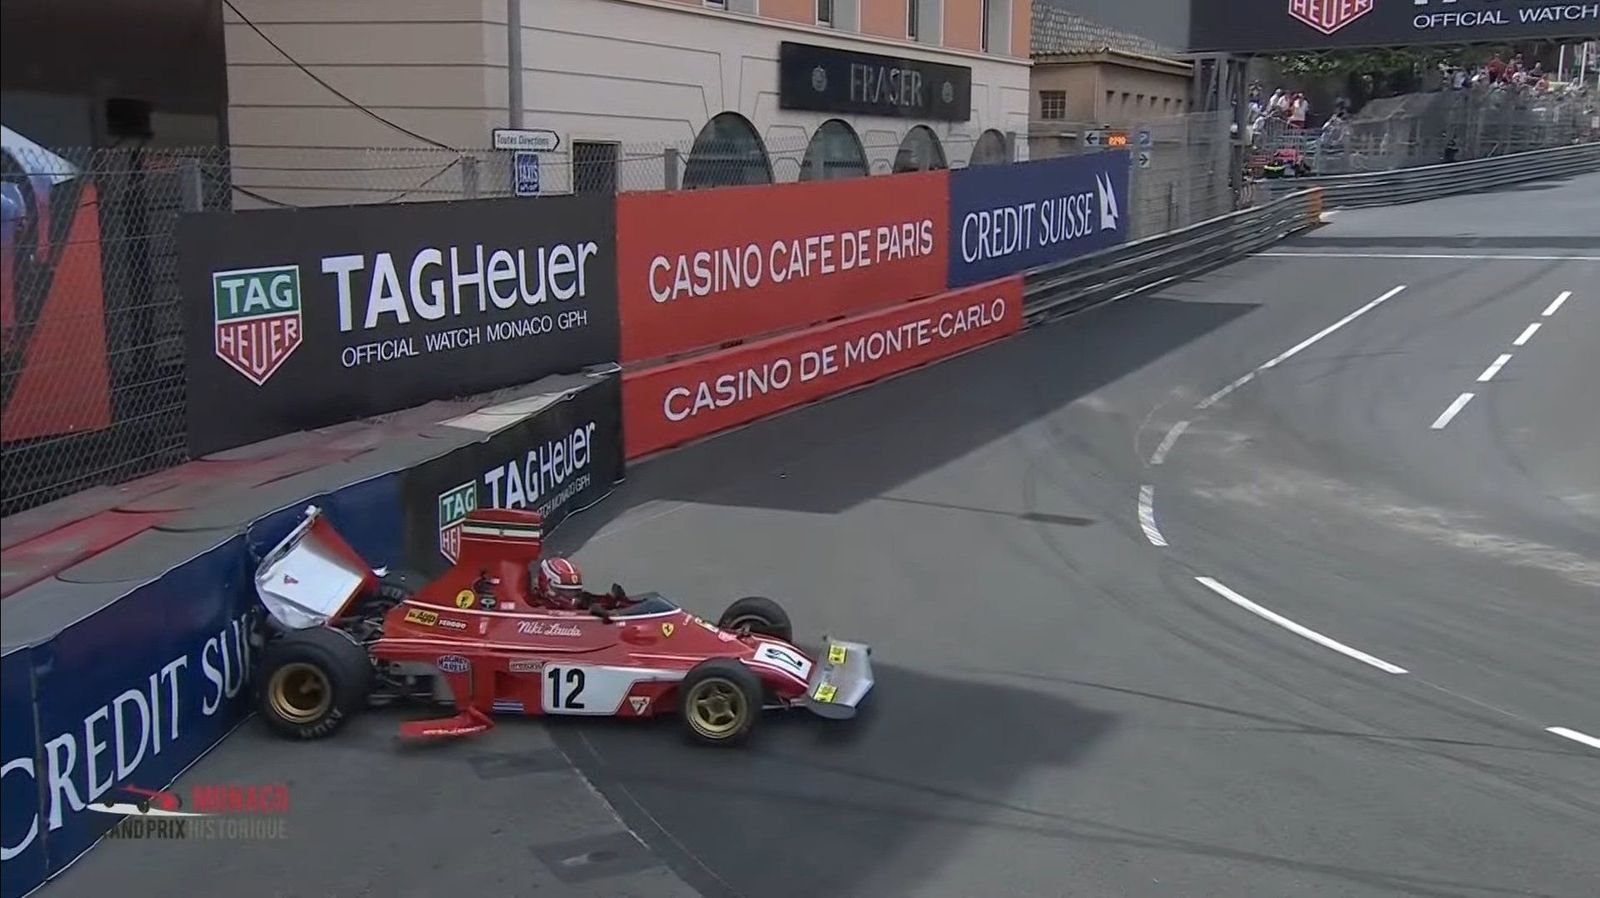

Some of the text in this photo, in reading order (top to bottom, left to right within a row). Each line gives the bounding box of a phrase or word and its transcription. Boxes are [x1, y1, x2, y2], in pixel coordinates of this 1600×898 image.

[1413, 5, 1599, 29] OFFICIAL WATCH
[851, 63, 922, 106] FRASER
[496, 134, 517, 145] Toutes
[961, 192, 1093, 263] CREDIT SUISSE
[649, 219, 933, 303] CASINO CAFE DE PARIS
[221, 274, 293, 314] TAG
[321, 241, 598, 332] TAGHeuer
[220, 318, 298, 376] HEUER
[341, 310, 588, 368] OFFICIAL WATCH MONACO GPH
[663, 298, 1006, 422] CASINO DE MONTE-CARLO
[442, 486, 474, 522] TAG
[575, 473, 591, 492] GPH
[517, 620, 582, 637] Niki Lauda
[548, 667, 585, 709] 12
[0, 655, 188, 860] CREDIT
